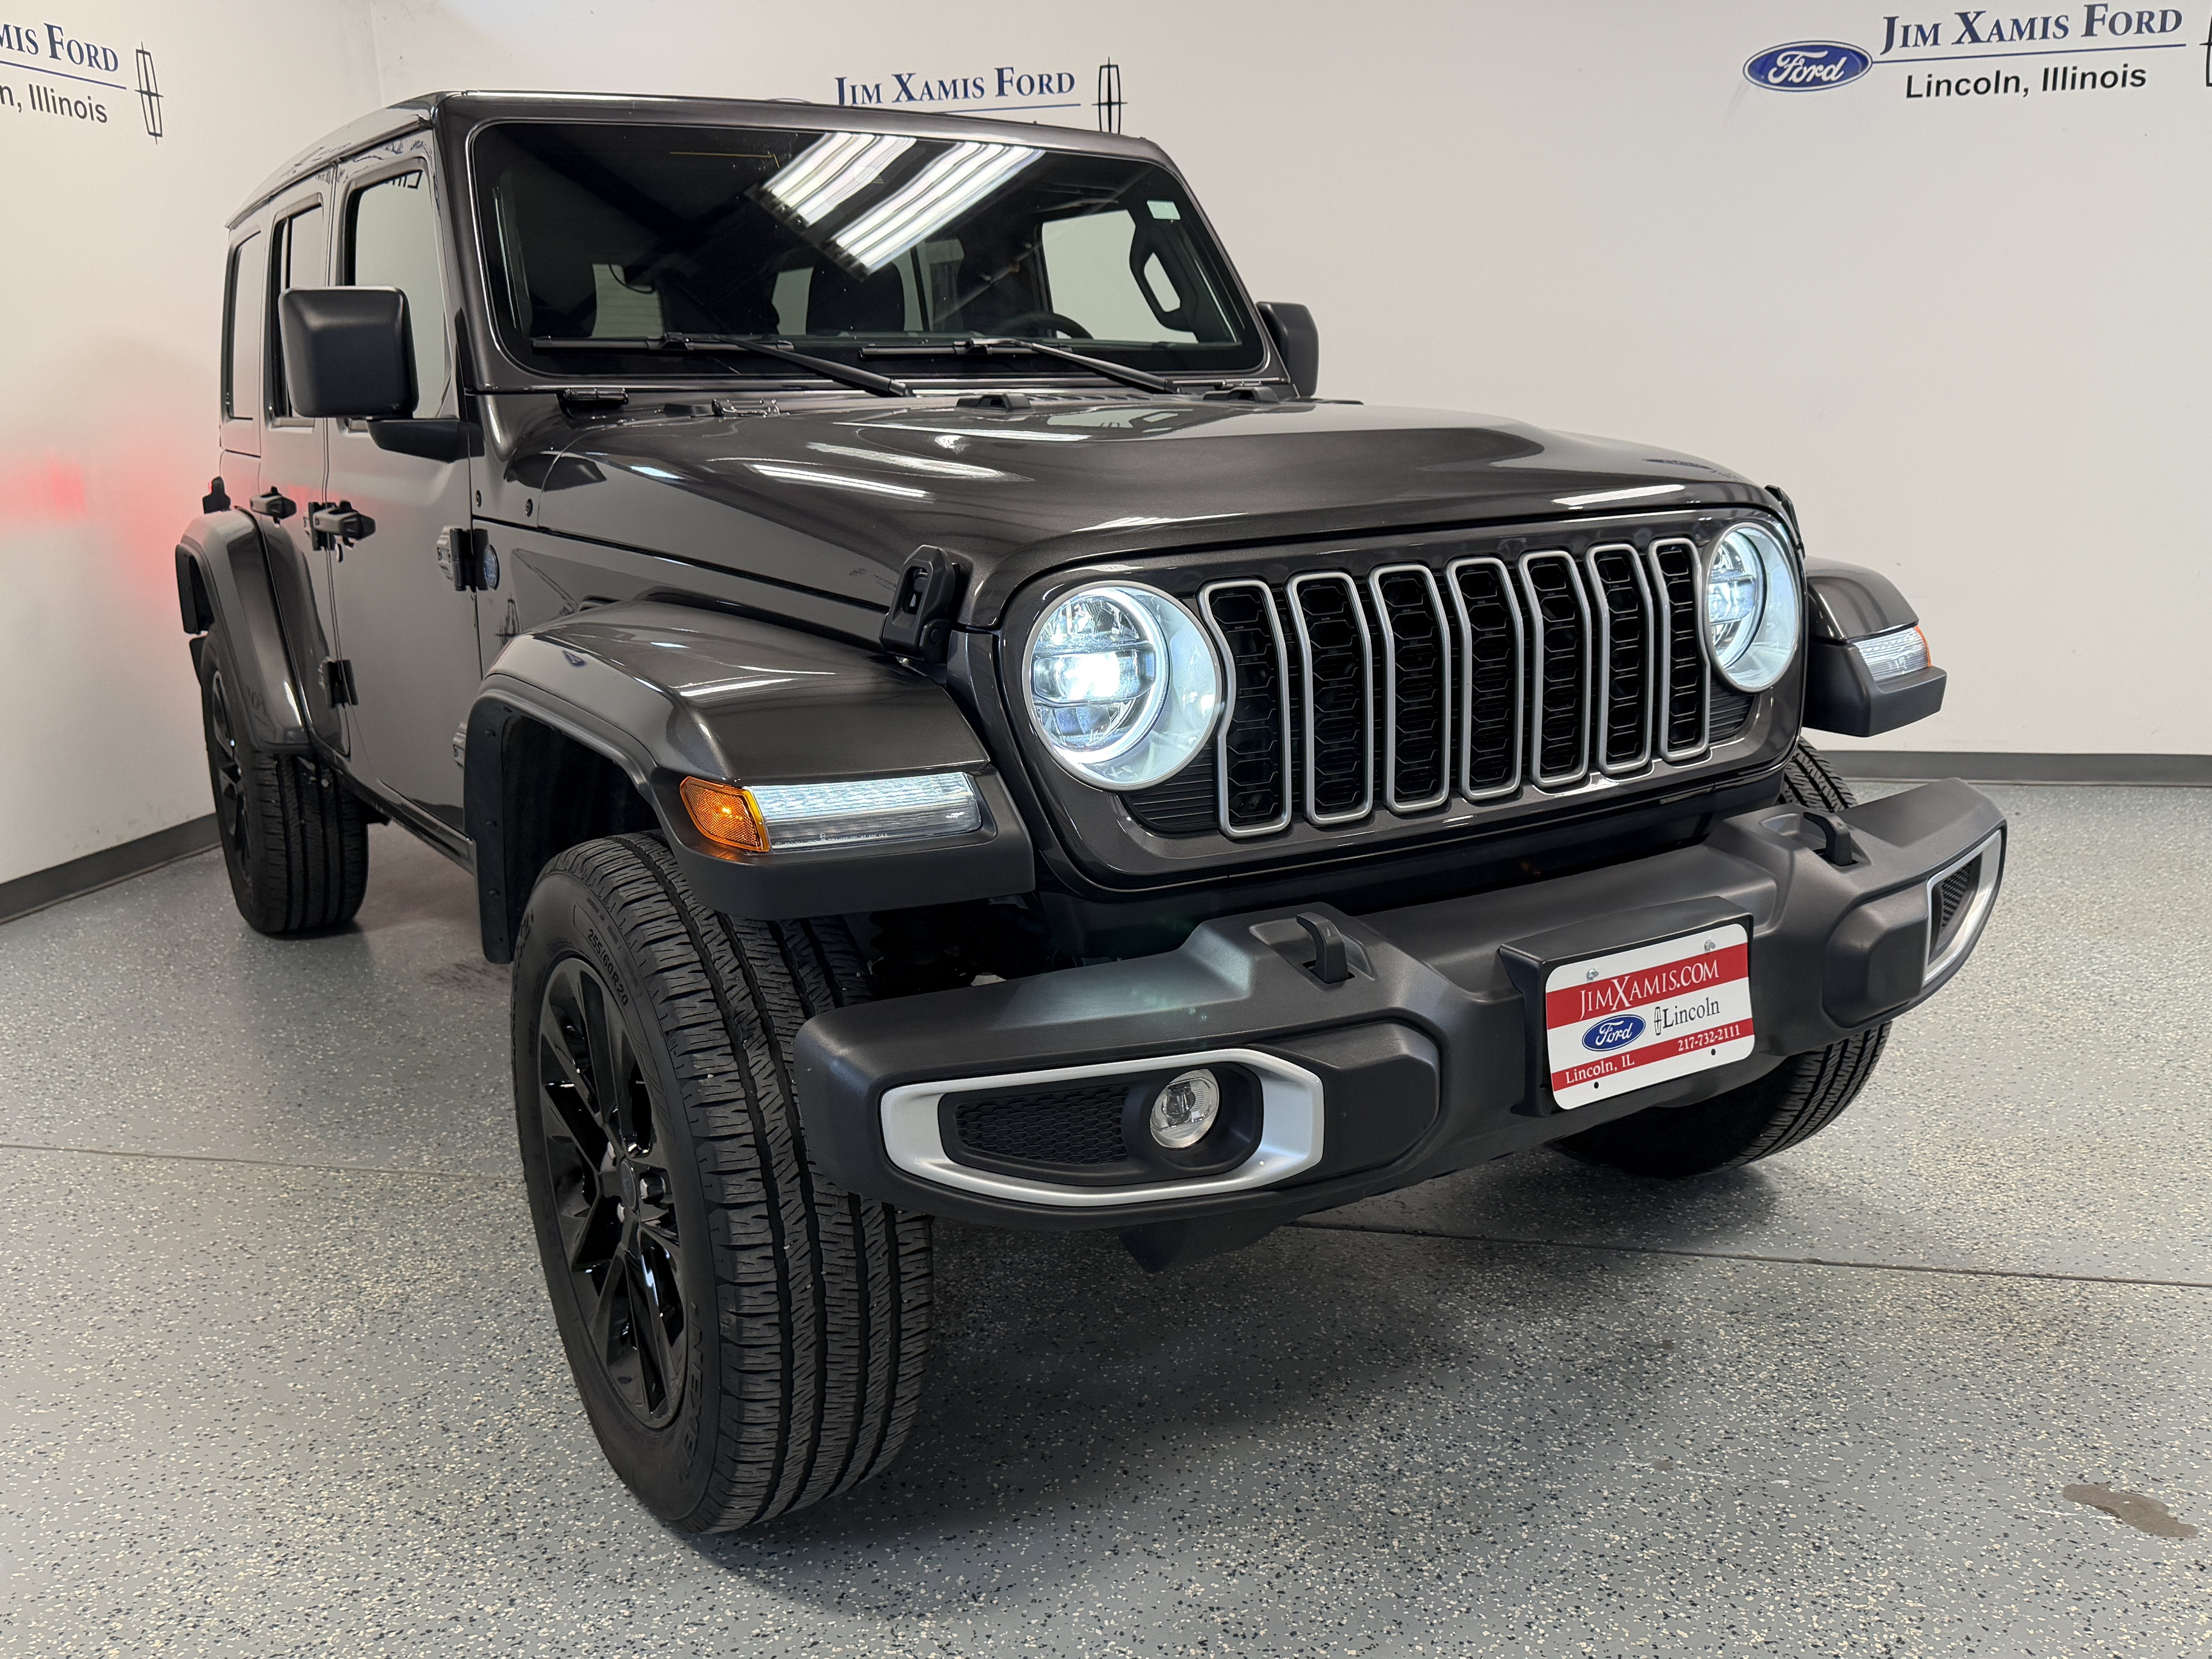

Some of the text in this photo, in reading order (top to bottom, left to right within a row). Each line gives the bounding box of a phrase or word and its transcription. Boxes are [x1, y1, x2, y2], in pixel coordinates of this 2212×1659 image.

[1880, 3, 2183, 55] JIM XAMIS FORD
[44, 22, 118, 72] FORD
[1768, 50, 1847, 84] Ford
[1906, 63, 2147, 98] Lincoln, Illinois
[891, 72, 984, 103] XAMIS
[994, 67, 1075, 97] FORD
[29, 84, 108, 123] Illinois
[587, 929, 628, 1006] 255/60R20
[1579, 959, 1719, 1020] JIMXAMIS.COM
[1662, 997, 1720, 1029] Lincoln
[1595, 1020, 1633, 1046] Ford
[1677, 1024, 1741, 1052] 217-732-2111
[1565, 1054, 1634, 1084] Lincoln, IL
